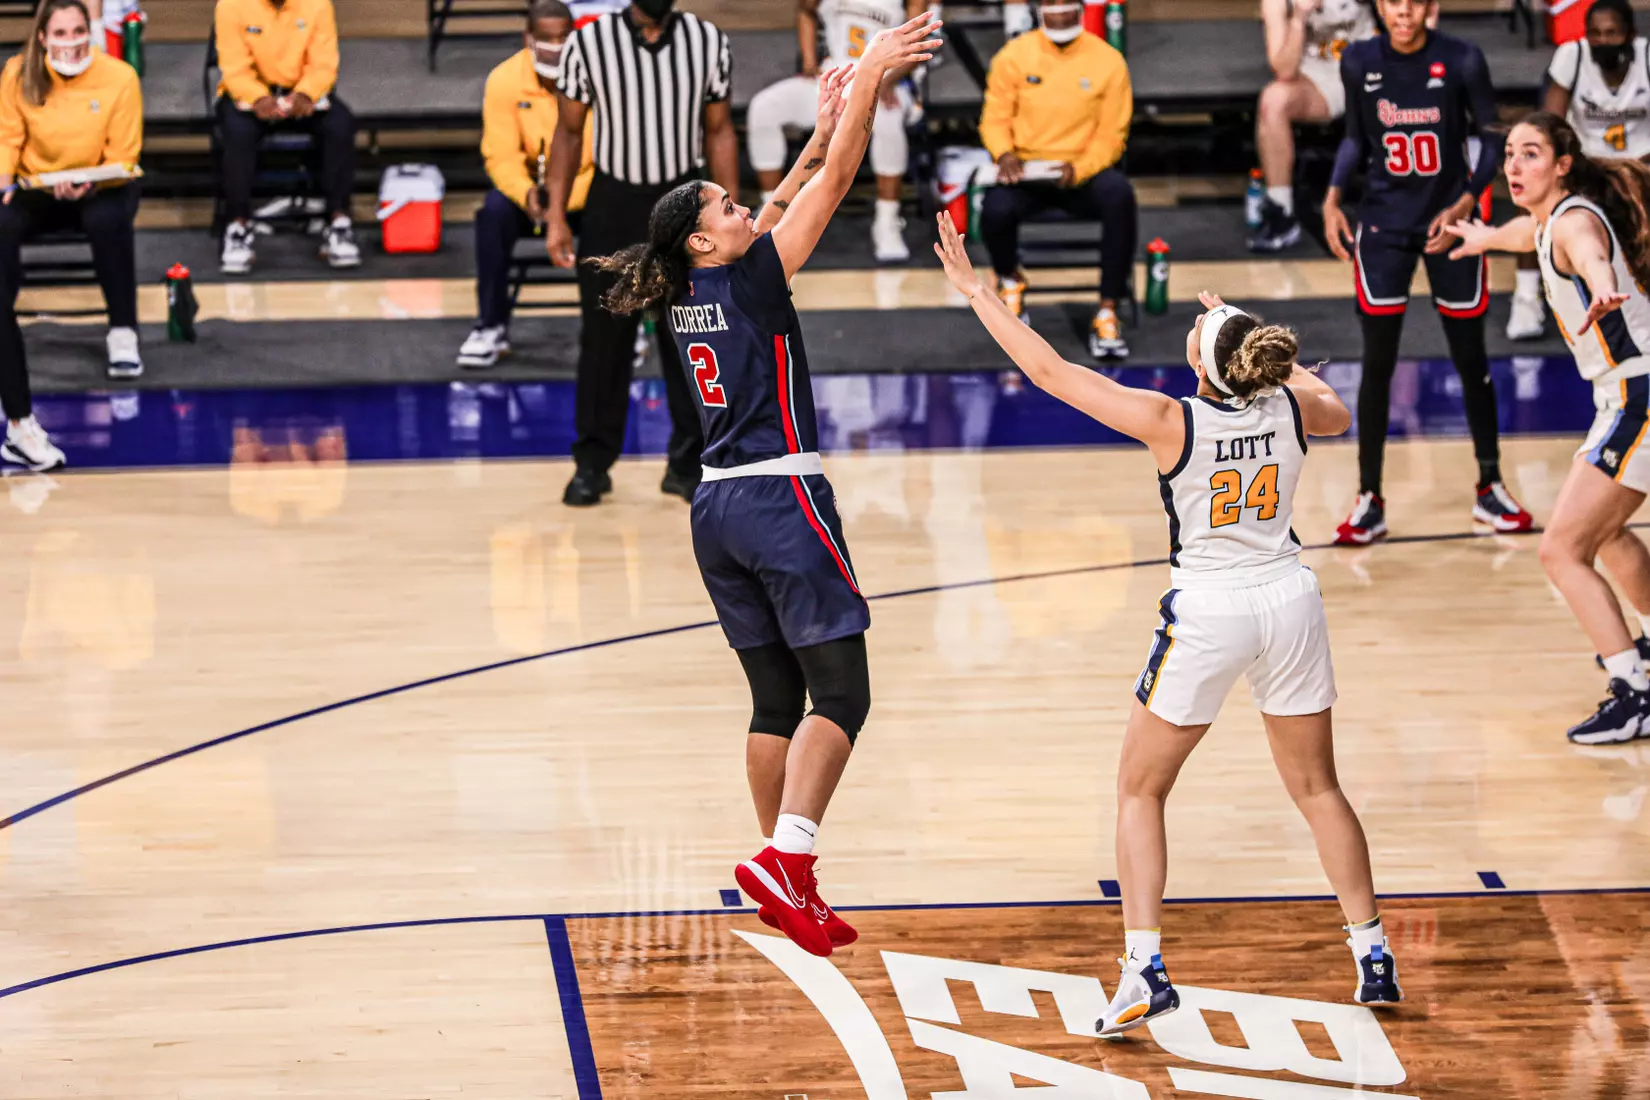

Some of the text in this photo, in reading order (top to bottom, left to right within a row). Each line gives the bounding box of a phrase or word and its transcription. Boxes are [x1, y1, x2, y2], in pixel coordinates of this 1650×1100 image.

[1382, 131, 1442, 177] 30
[670, 302, 730, 334] CORREA
[686, 342, 728, 409] 2
[1214, 430, 1276, 463] LOTT
[1209, 463, 1280, 529] 24
